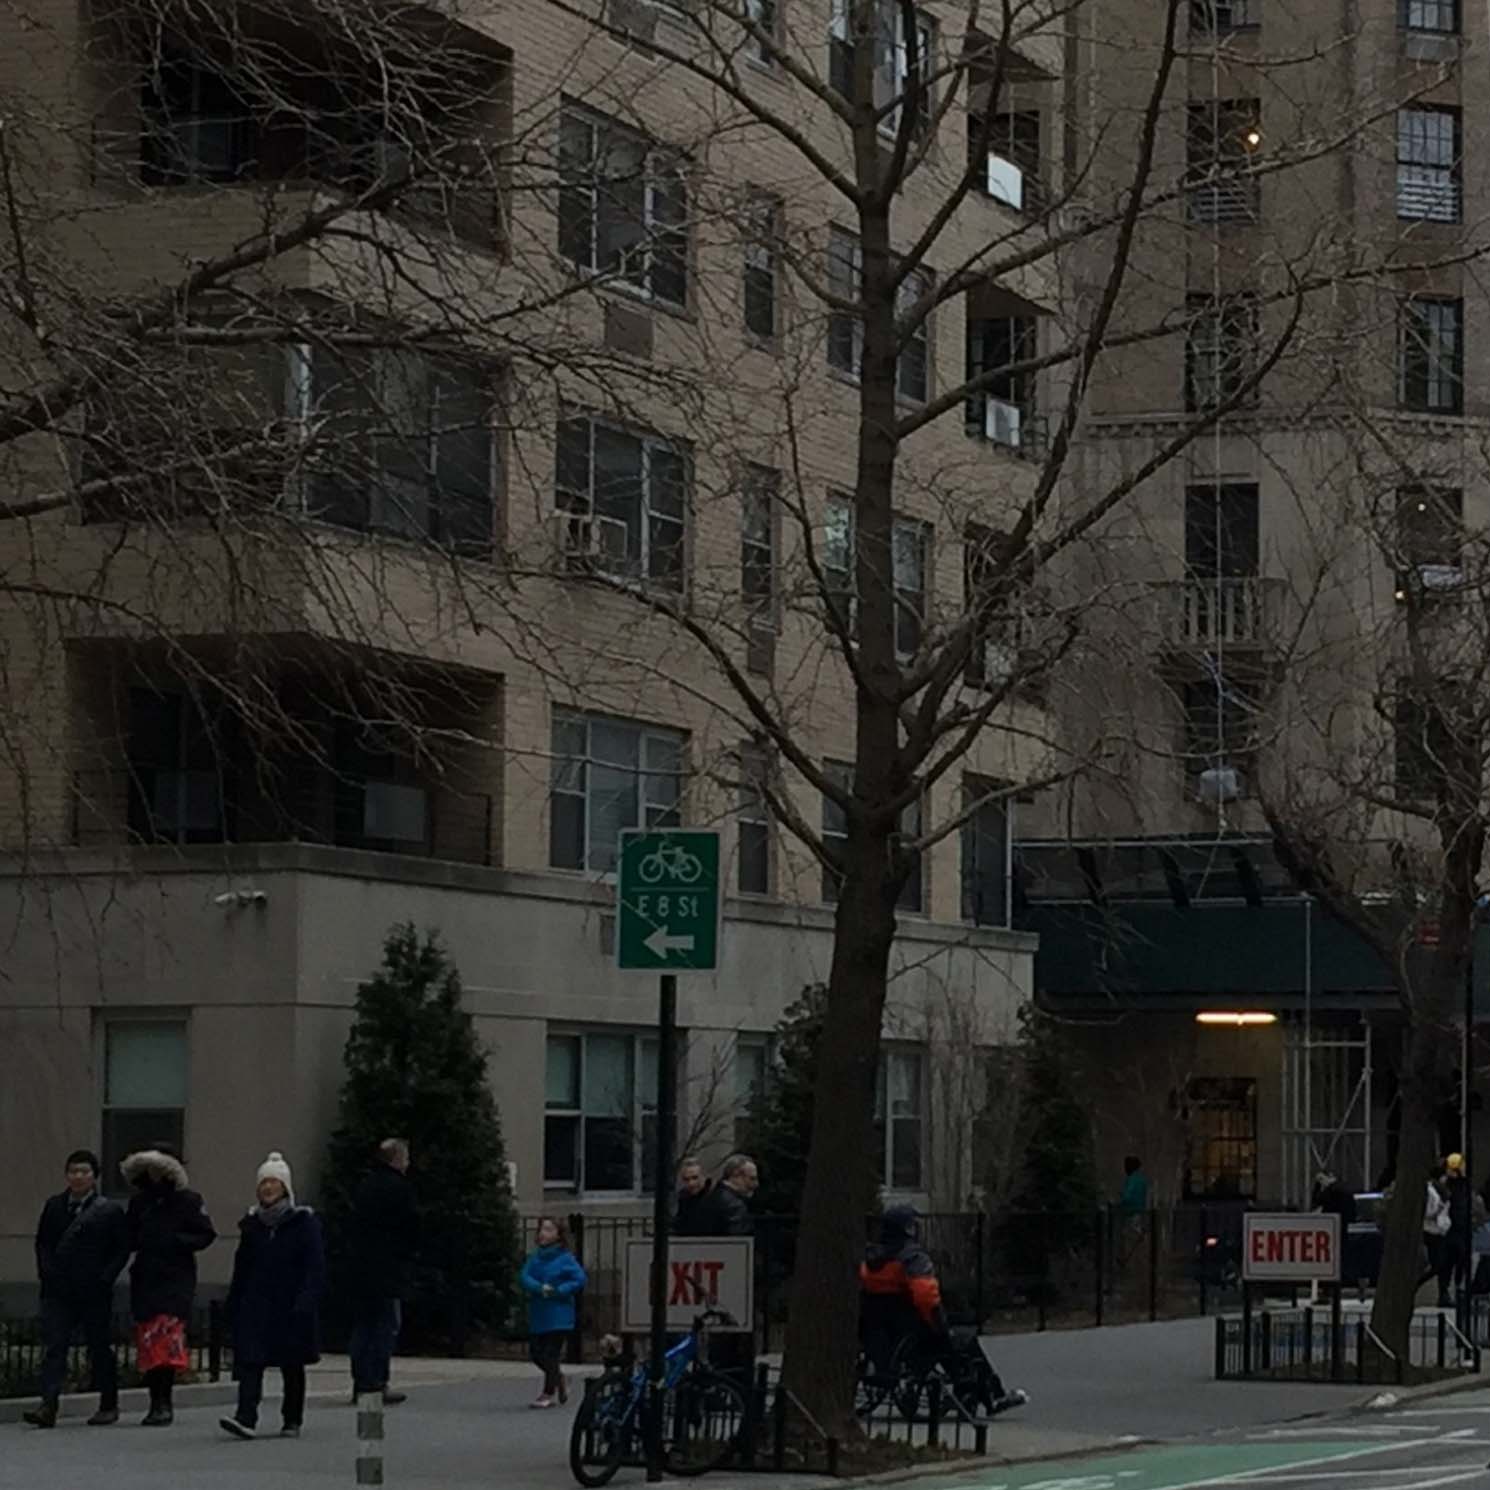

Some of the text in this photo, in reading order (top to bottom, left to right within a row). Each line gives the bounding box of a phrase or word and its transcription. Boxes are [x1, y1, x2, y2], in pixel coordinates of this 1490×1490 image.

[638, 895, 699, 917] E 8 St
[1252, 1230, 1331, 1263] ENTER
[650, 1261, 725, 1306] XIT
